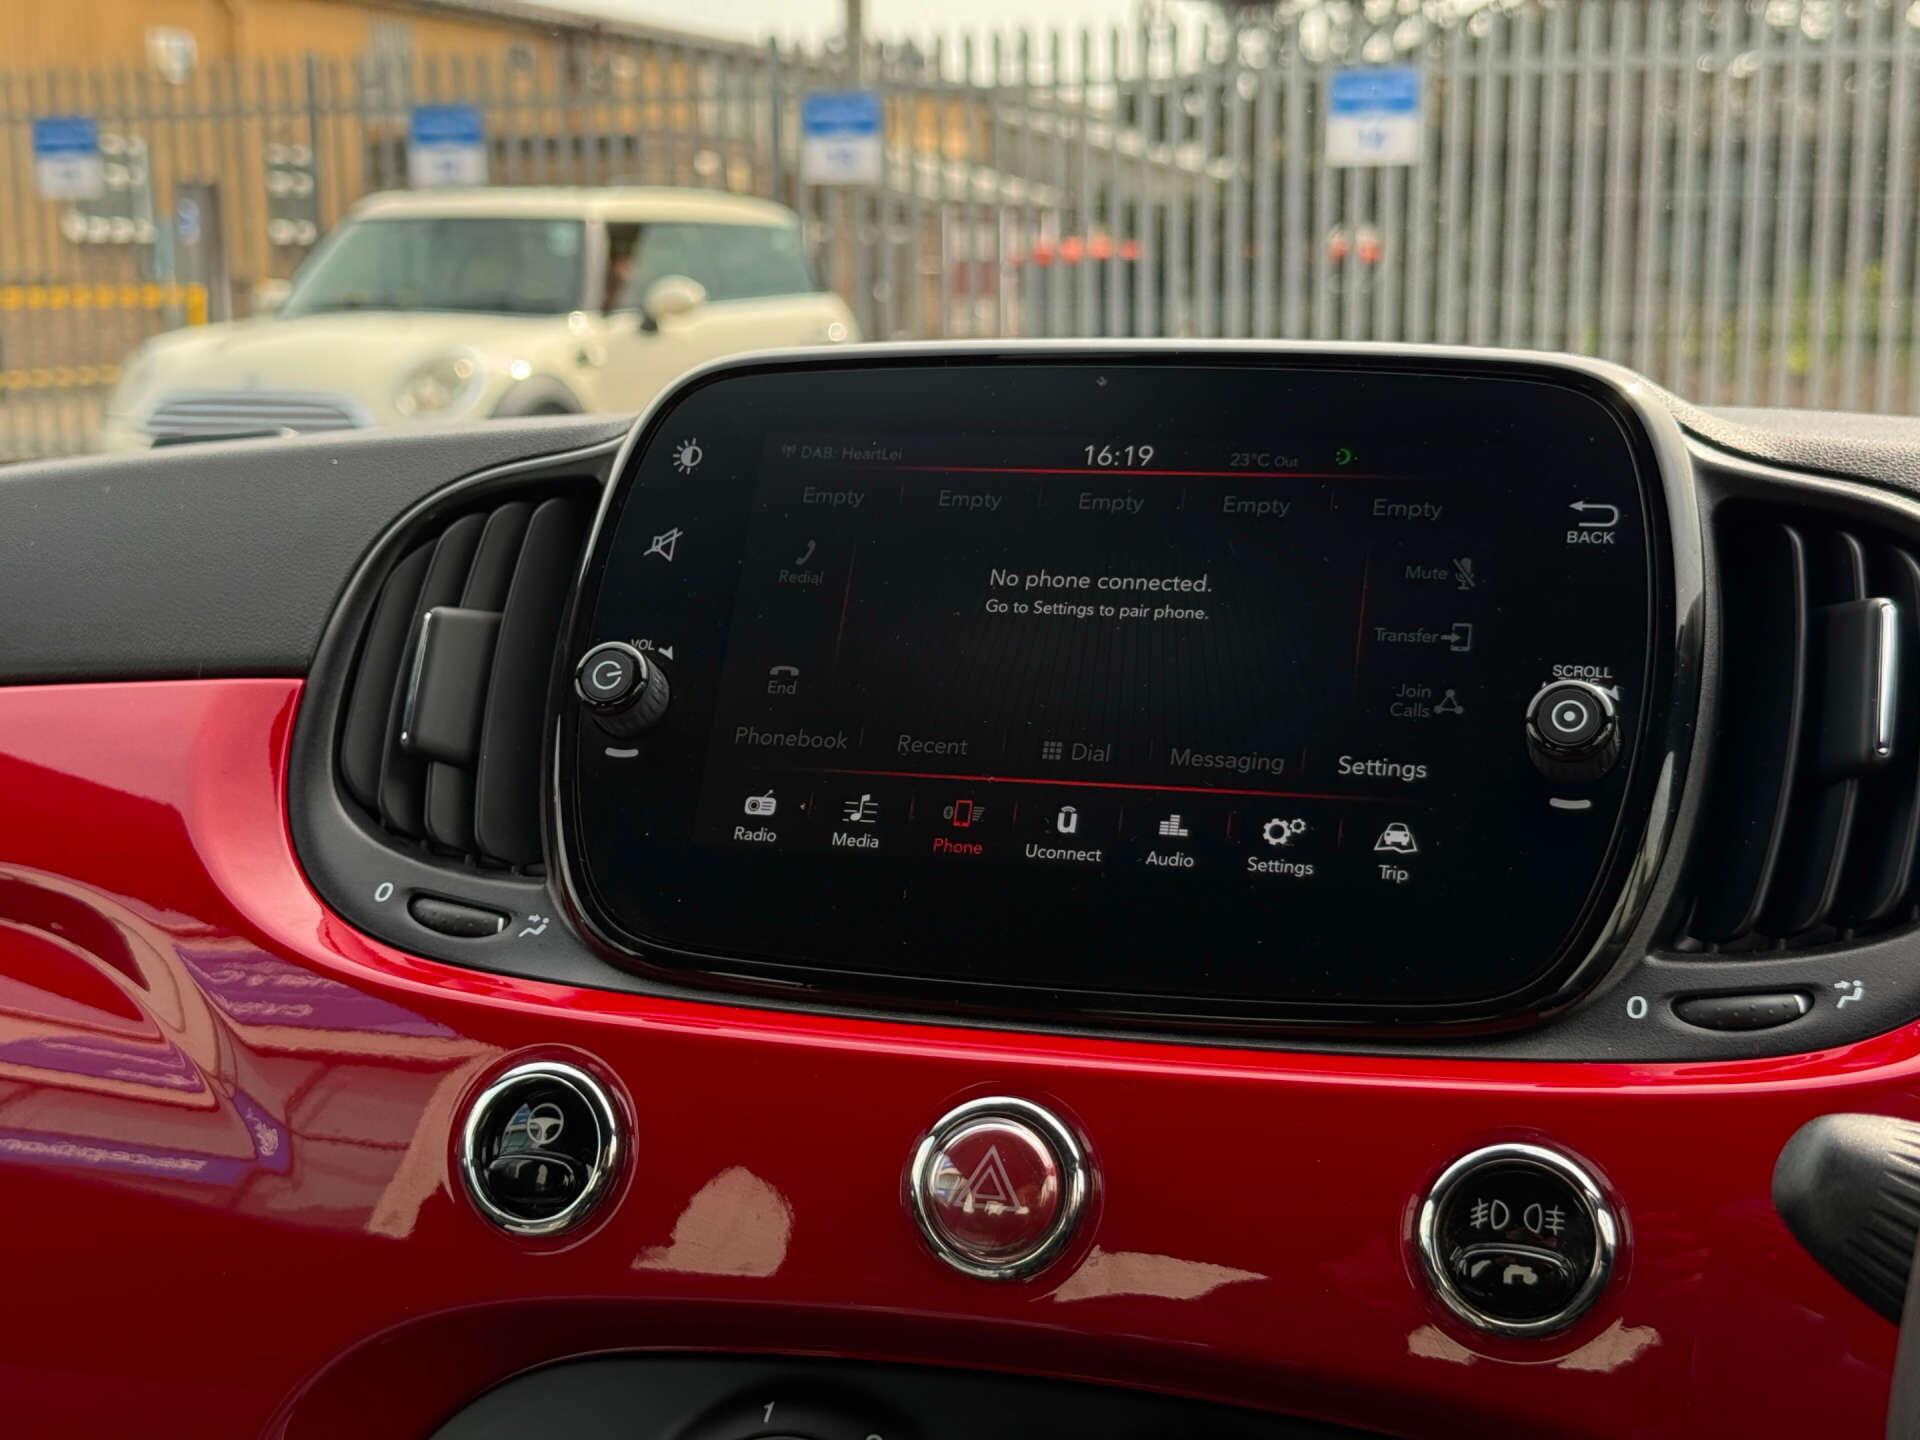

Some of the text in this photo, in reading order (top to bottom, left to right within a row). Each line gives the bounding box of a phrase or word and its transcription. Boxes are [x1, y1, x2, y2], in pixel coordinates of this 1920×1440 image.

[1084, 444, 1154, 467] 16:19
[1274, 455, 1298, 469] Out
[802, 486, 865, 508] Empty
[938, 489, 1002, 511] Empty
[1078, 491, 1145, 514] Empty
[1224, 495, 1291, 517] Empty
[1372, 499, 1443, 521] Empty
[1567, 530, 1616, 545] BACK
[778, 568, 824, 585] Redial
[989, 568, 1212, 594] No phone connected.
[1405, 564, 1448, 582] Mute
[985, 598, 1209, 623] Go to Settings to pair phone.
[630, 638, 658, 653] VOL
[1375, 627, 1440, 646] Transfer
[1552, 664, 1613, 678] SCROLL
[768, 679, 798, 696] End
[1395, 682, 1433, 699] Join
[1389, 701, 1431, 720] Calls
[734, 726, 849, 751] Phonebook
[897, 734, 969, 756] Recent
[1072, 743, 1111, 763] Dial
[1170, 747, 1285, 773] Messaging
[1337, 755, 1429, 782] Settings
[733, 826, 777, 843] Radio
[832, 832, 880, 849] Media
[932, 838, 983, 856] Phone
[1026, 844, 1102, 863] Uconnect
[1146, 851, 1195, 869] Audio
[1248, 857, 1314, 877] Settings
[1378, 865, 1409, 884] Trip
[762, 1400, 776, 1425] 1
